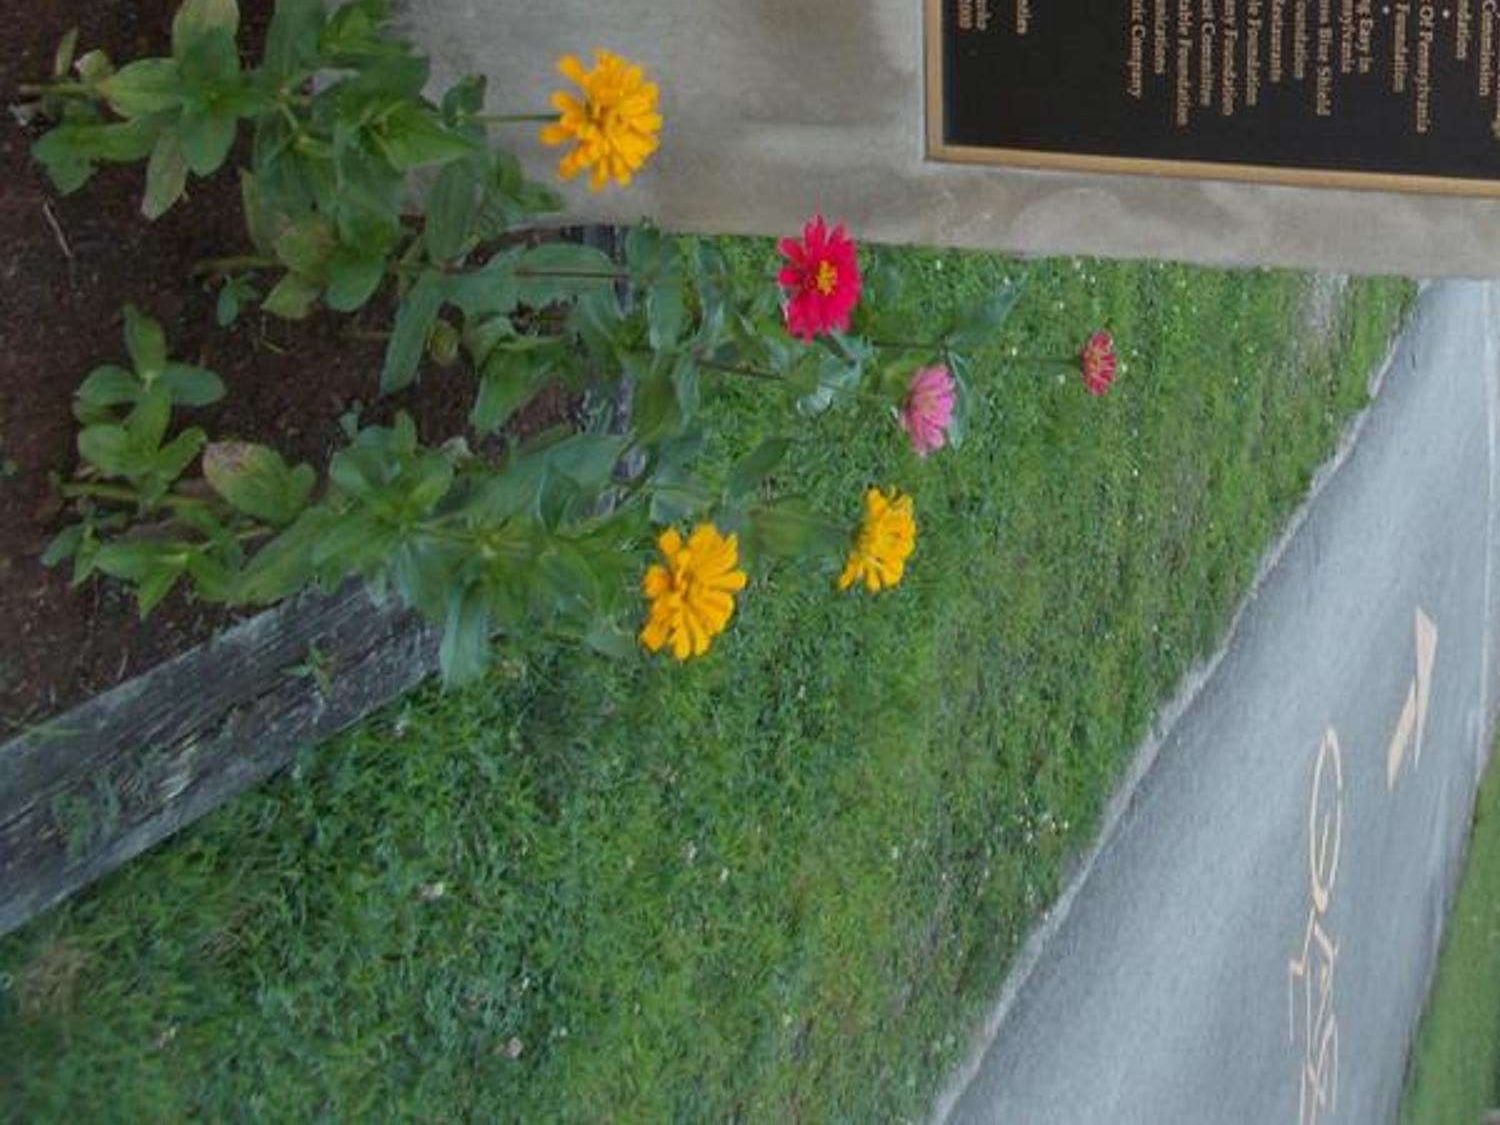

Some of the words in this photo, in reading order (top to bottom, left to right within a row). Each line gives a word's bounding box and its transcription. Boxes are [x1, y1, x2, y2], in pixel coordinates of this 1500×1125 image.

[1126, 25, 1146, 98] Company
[1176, 39, 1192, 126] Foundation
[1200, 22, 1215, 107] Committee
[1222, 28, 1238, 116] Foundation
[1318, 27, 1332, 63] Blue
[1393, 4, 1410, 93] Foundation
[1414, 31, 1433, 133] Pennsylvania
[1316, 66, 1332, 116] Shield
